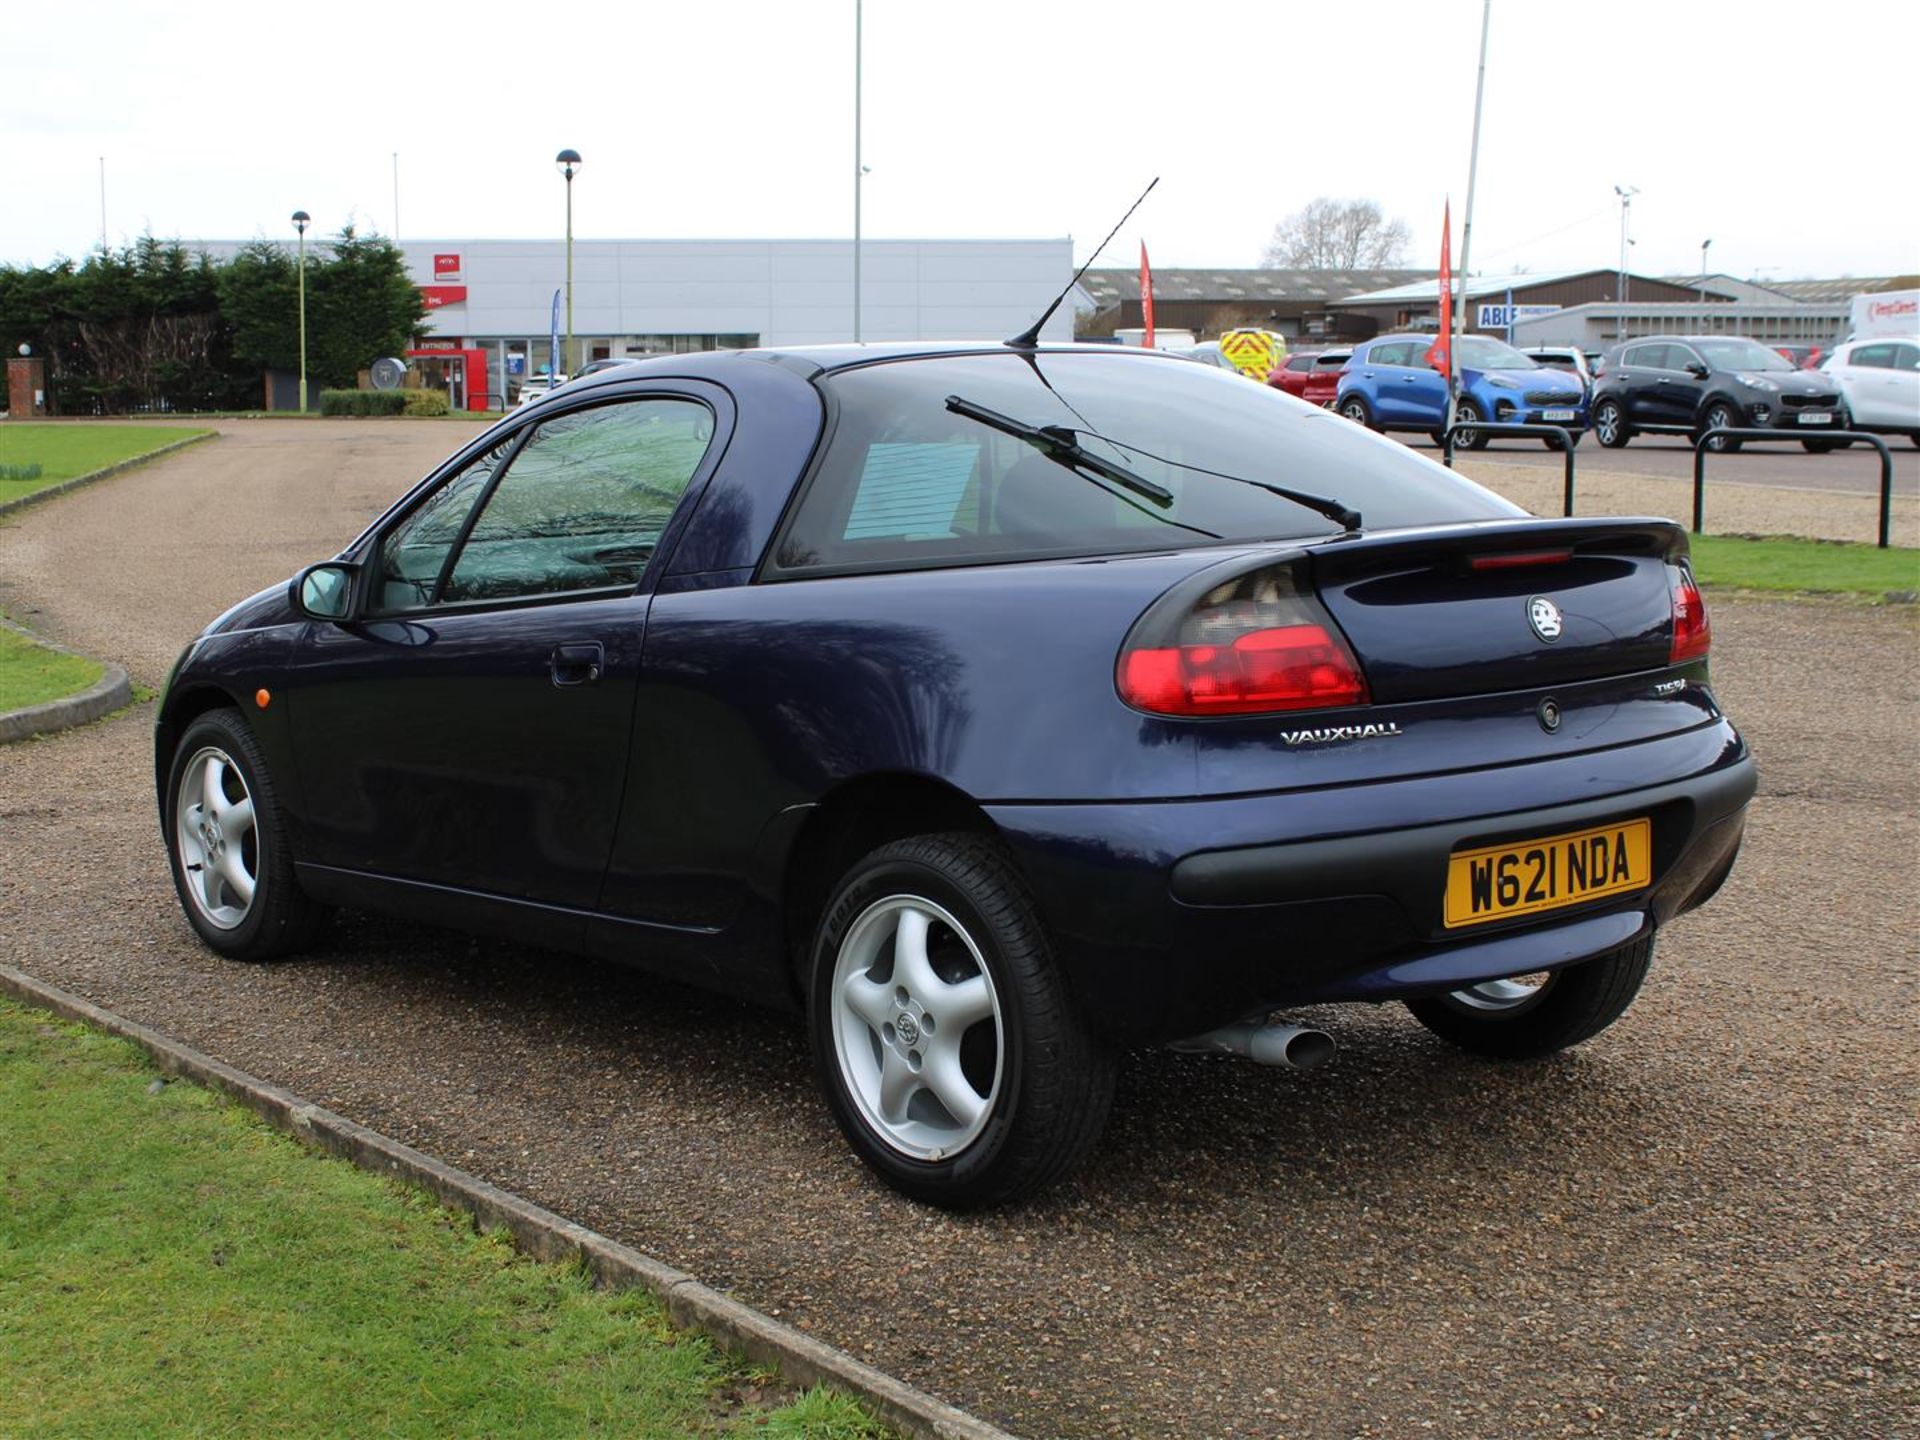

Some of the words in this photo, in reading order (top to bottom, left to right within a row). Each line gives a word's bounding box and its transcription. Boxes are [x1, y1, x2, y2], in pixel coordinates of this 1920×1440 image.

[1280, 722, 1403, 745] VAUXHALL
[1470, 847, 1556, 913] W621
[1568, 832, 1630, 893] NDA
